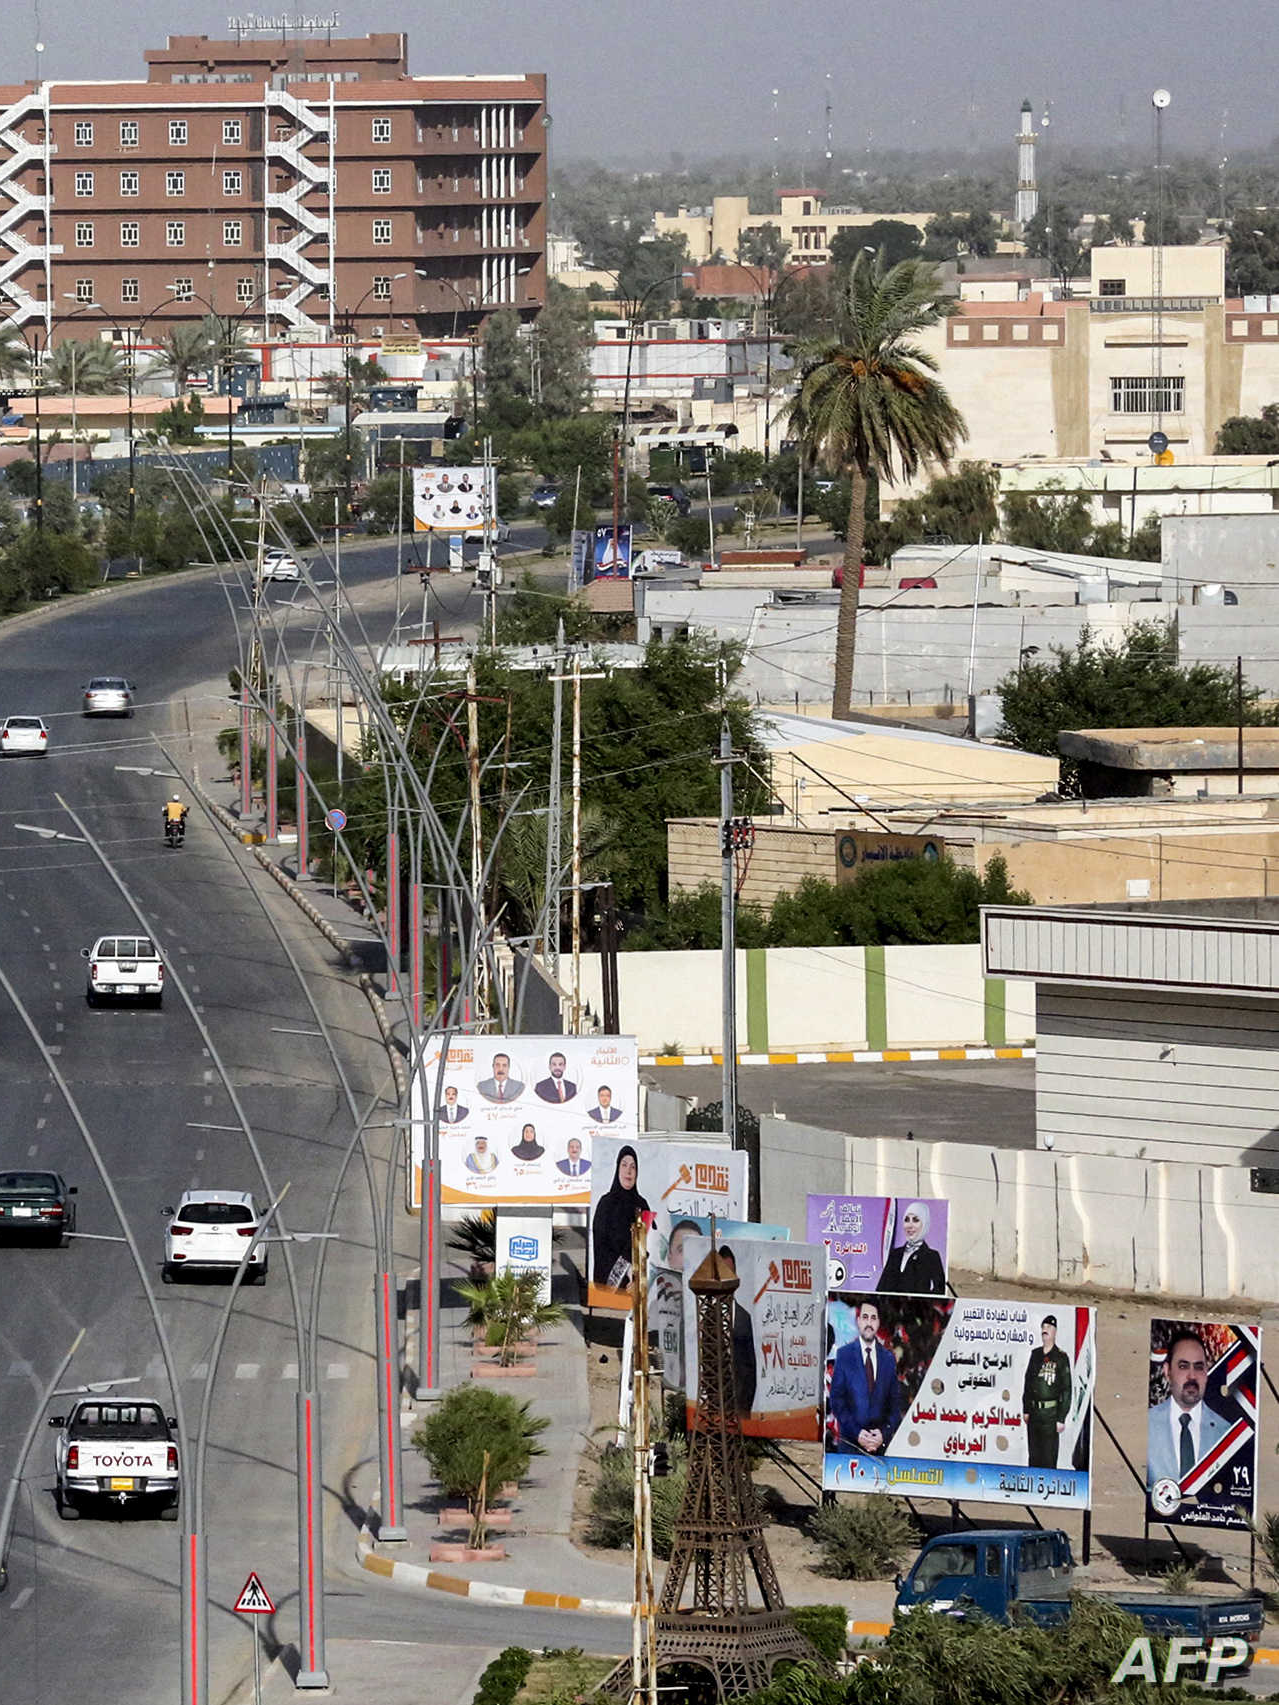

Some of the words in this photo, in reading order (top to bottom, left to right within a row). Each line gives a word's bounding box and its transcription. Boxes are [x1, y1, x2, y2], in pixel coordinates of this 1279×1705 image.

[835, 1241, 867, 1255] الدائرة
[963, 1307, 985, 1322] التغيير
[986, 1308, 1009, 1324] لقيادة
[1009, 1309, 1028, 1324] شباب
[995, 1327, 1028, 1344] المشاركة
[761, 1340, 786, 1369] ٣٨
[945, 1350, 981, 1368] المستقل
[982, 1352, 1013, 1371] المرشح
[957, 1371, 997, 1393] الحقوقي
[939, 1407, 968, 1424] محمد
[972, 1405, 1022, 1431] عبدالكريم
[93, 1455, 153, 1467] TOYOTA
[886, 1464, 944, 1486] التسلسل
[1232, 1465, 1250, 1486] ٢٩
[999, 1471, 1034, 1499] الثانية
[1037, 1475, 1076, 1501] الدائرة
